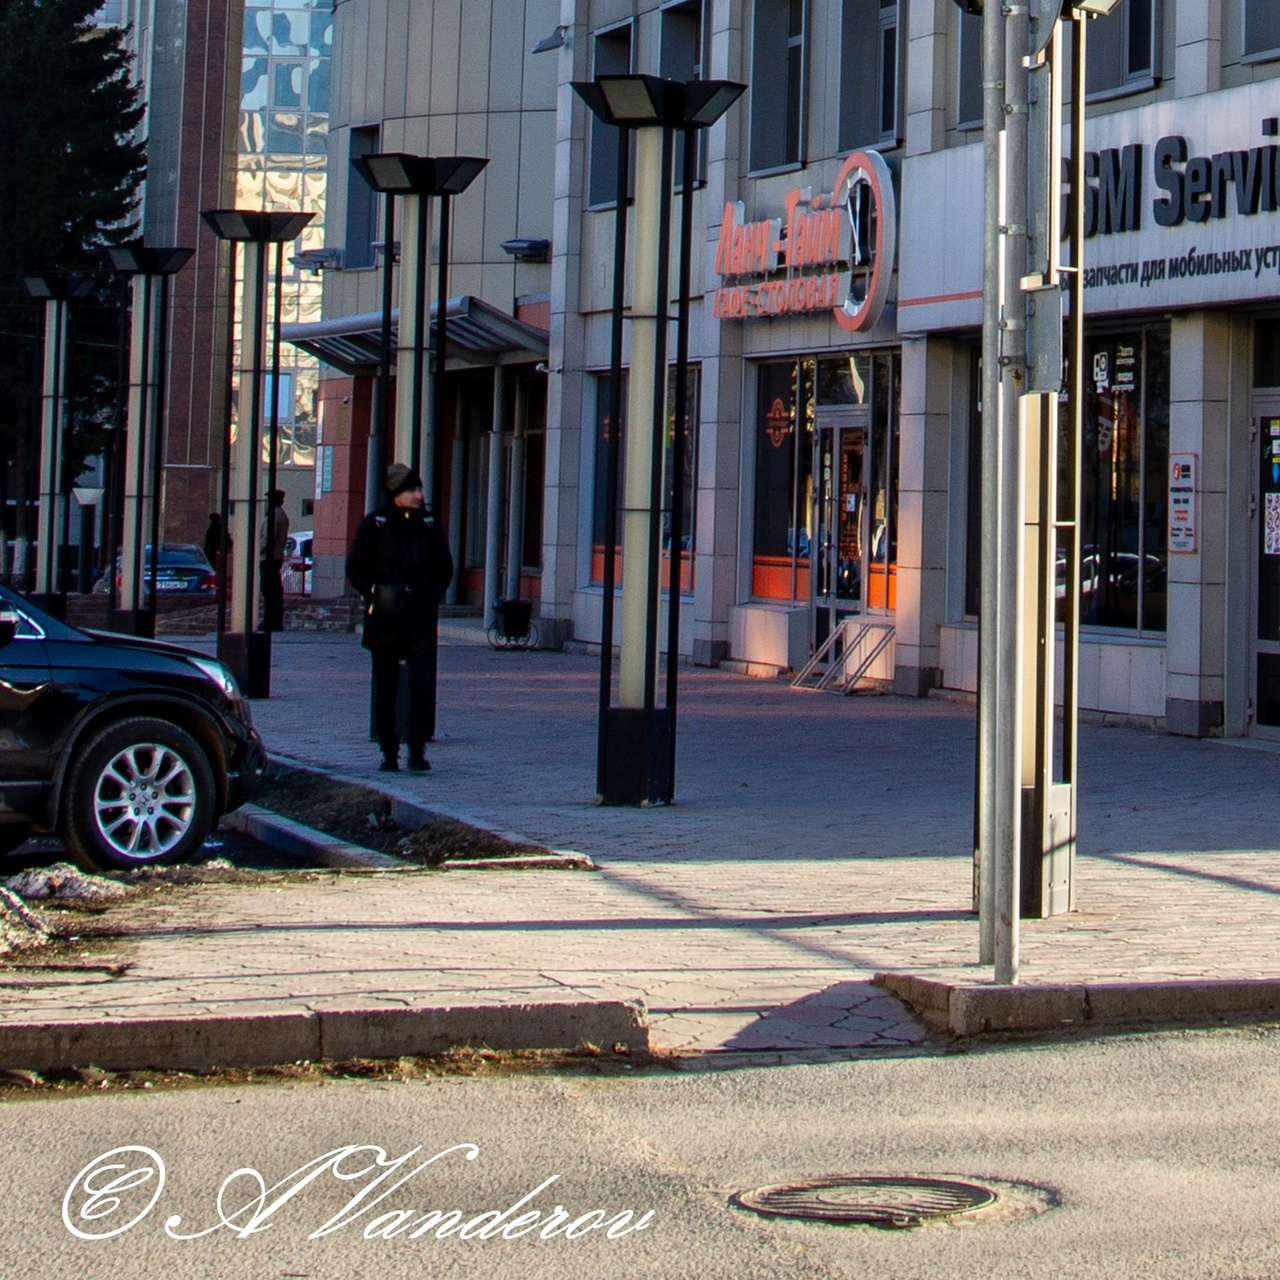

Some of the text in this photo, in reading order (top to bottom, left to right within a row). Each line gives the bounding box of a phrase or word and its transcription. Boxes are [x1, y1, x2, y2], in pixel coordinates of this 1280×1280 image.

[1083, 265, 1138, 290] запчасти
[1140, 258, 1166, 288] для
[1167, 246, 1253, 280] мобильных
[712, 272, 840, 319] КАФЕ-СТОЛОВАЯ
